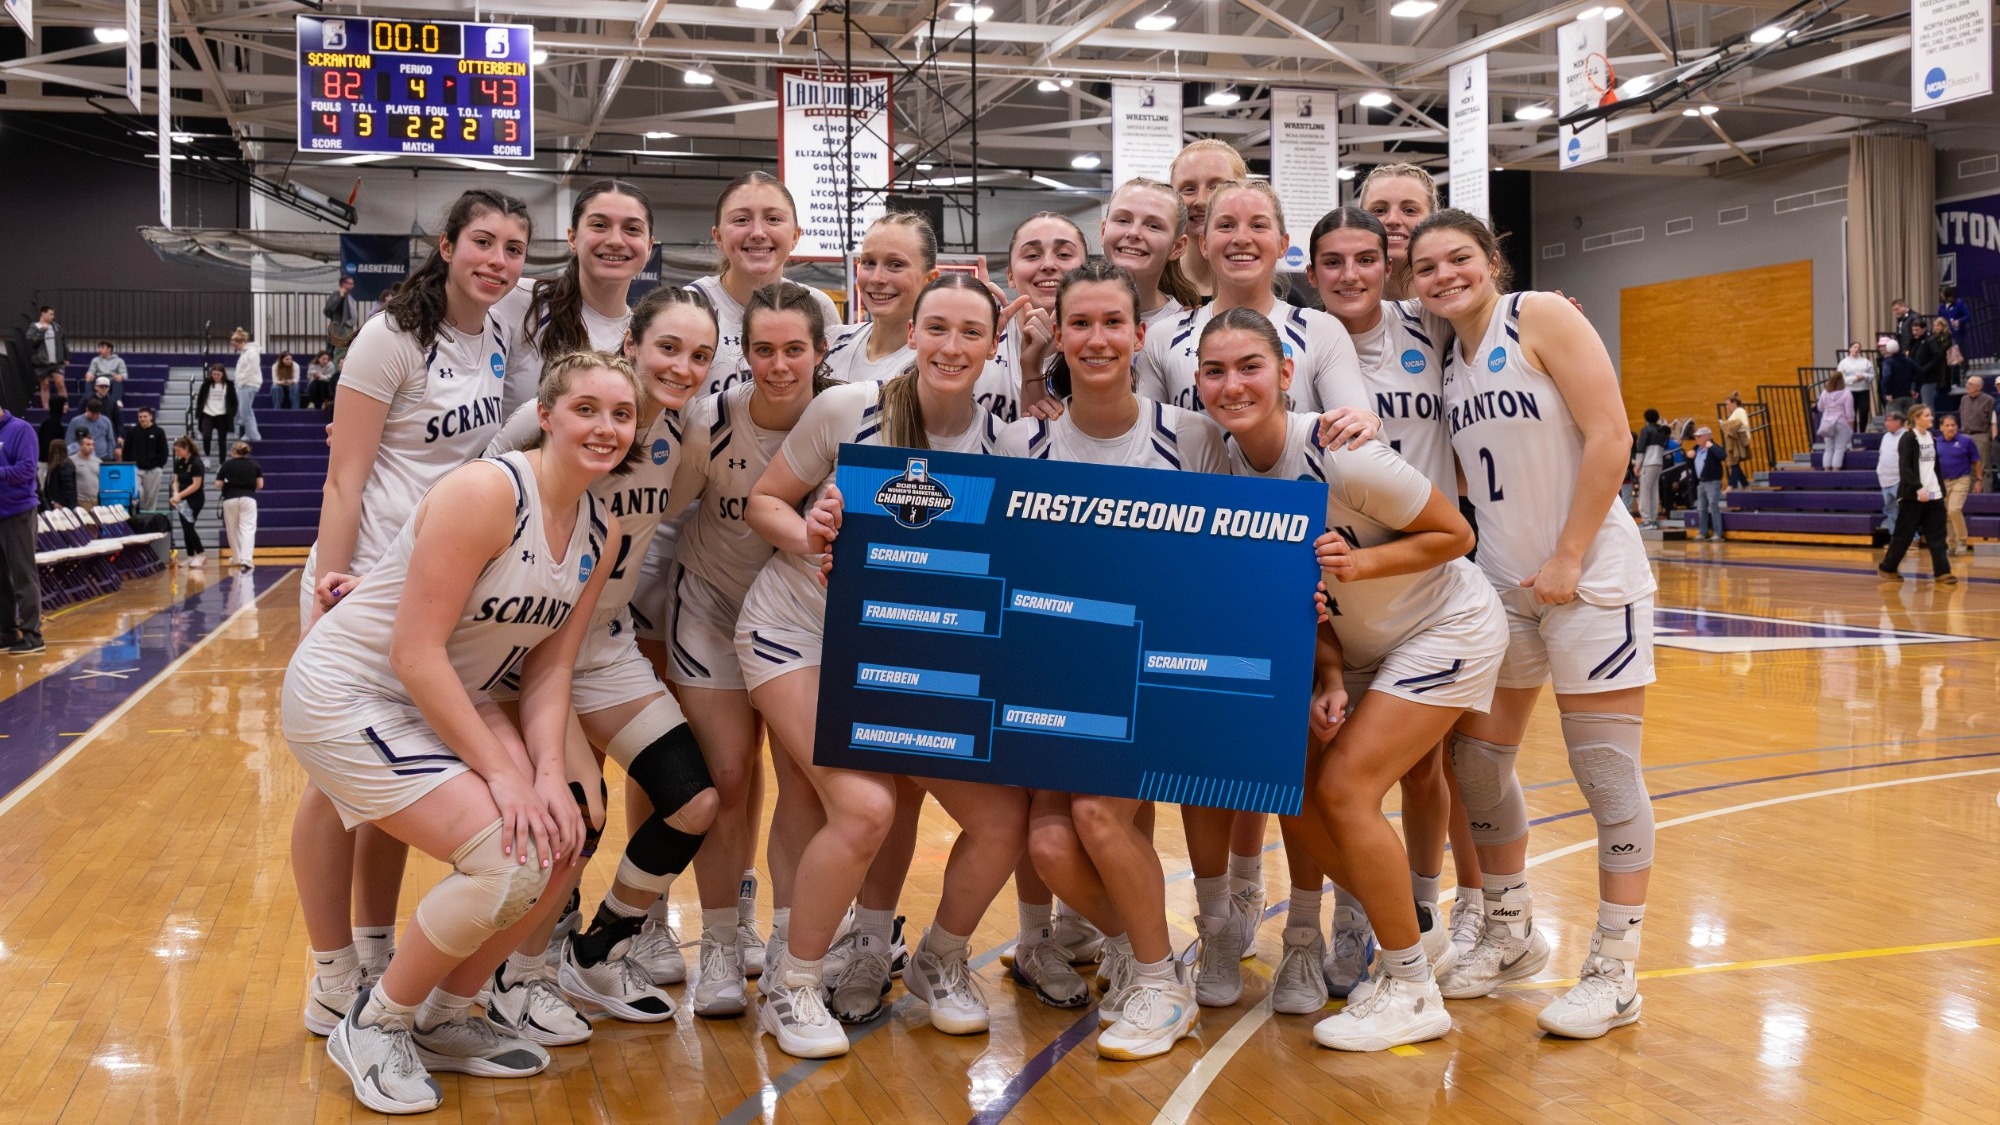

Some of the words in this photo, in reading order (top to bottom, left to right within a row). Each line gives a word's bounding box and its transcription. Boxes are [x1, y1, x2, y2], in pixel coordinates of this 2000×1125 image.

[1923, 20, 1943, 32] NORTH
[1944, 10, 1980, 26] CHAMPIONS
[375, 22, 438, 52] 00.0
[308, 52, 371, 69] SCRANTON
[400, 63, 432, 75] PERIOD
[458, 60, 527, 76] OTTERBEIN
[323, 71, 362, 100] 82
[410, 78, 425, 99] 4
[481, 79, 517, 107] 43
[311, 101, 341, 112] FOULS
[351, 103, 377, 114] T.O.L.
[386, 105, 420, 116] PLAYER
[426, 106, 449, 117] FOUL
[458, 107, 483, 118] T.O.L.
[492, 109, 521, 120] FOULS
[322, 114, 337, 134] 4
[358, 114, 372, 137] 3
[1126, 113, 1169, 122] WRESTLING
[1284, 122, 1325, 130] WRESTLING
[463, 118, 477, 141] 2
[505, 120, 517, 142] 3
[312, 138, 342, 149] SCORE
[402, 141, 435, 153] MATCH
[493, 145, 522, 156] SCORE
[357, 263, 406, 274] BASKETBALL
[1404, 360, 1425, 368] NCAA
[1490, 356, 1506, 367] NCAA
[425, 396, 504, 444] SCRANT
[1448, 390, 1542, 440] RANTON
[1479, 447, 1504, 503] 2
[877, 492, 951, 508] CHAMPIONSHIP
[887, 487, 911, 495] WOMEN'S
[912, 489, 943, 497] BASKETBALL
[1006, 490, 1205, 534] FIRST/SECOND
[1210, 507, 1310, 543] ROUND
[870, 548, 929, 565] SCRANTON
[473, 596, 574, 630] SCRANT
[1013, 594, 1074, 615] SCRANTON
[865, 606, 939, 625] FRAMINGHAM
[942, 612, 959, 626] ST.
[1147, 655, 1208, 673] SCRANTON
[861, 668, 920, 687] OTTERBEIN
[1006, 710, 1066, 728] OTTERBEIN
[855, 728, 957, 750] RANDOLPH-MACON
